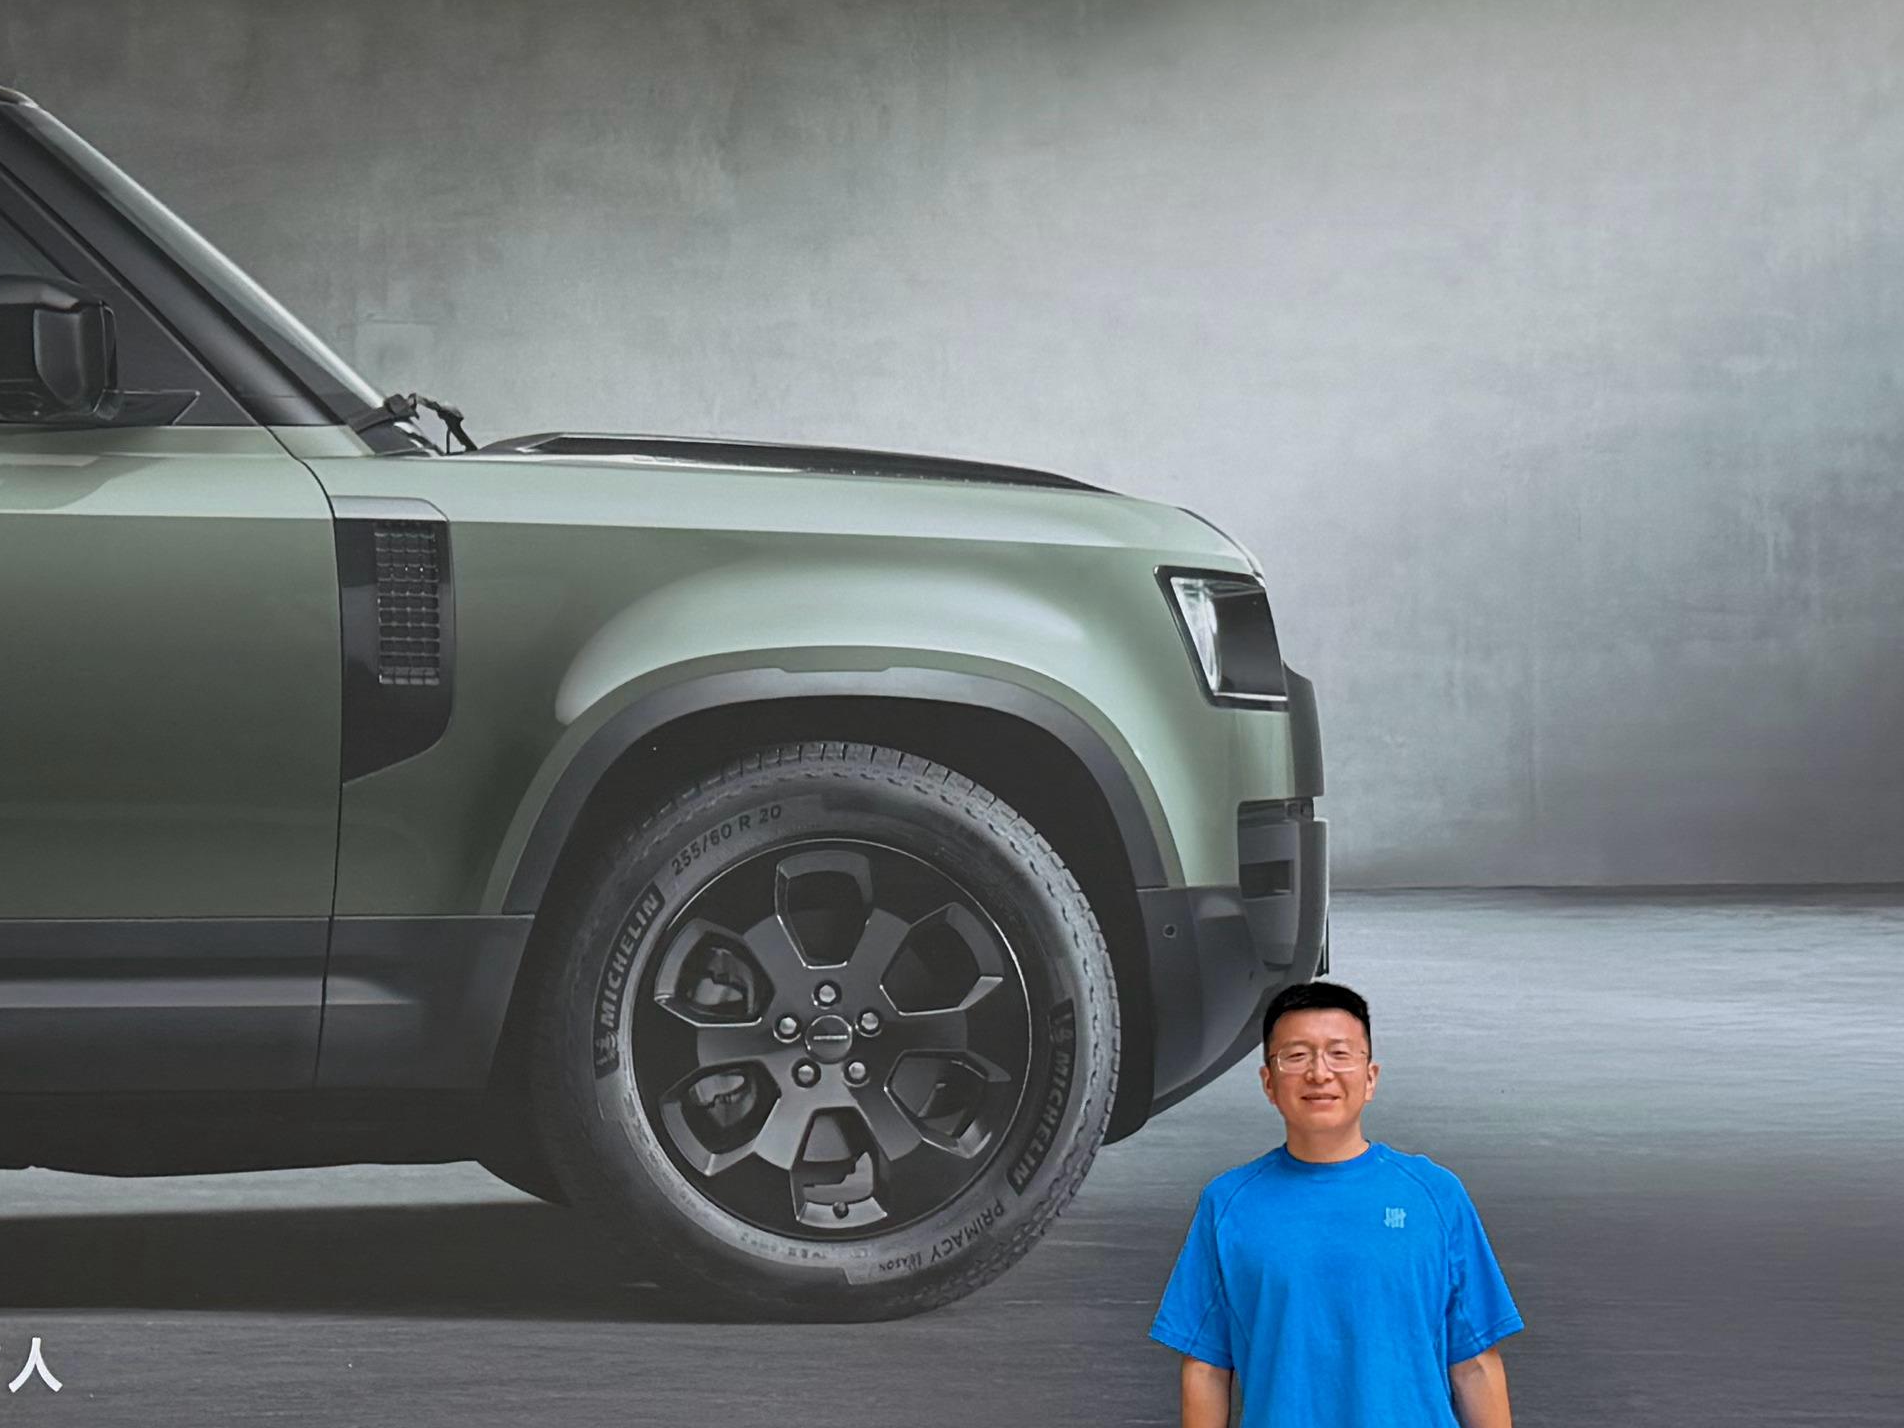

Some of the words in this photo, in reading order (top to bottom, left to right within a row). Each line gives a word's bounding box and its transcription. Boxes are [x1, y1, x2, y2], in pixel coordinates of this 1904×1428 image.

[738, 814, 752, 832] R
[759, 805, 783, 824] 20
[599, 893, 660, 1030] MICHELIN
[1013, 1052, 1072, 1190] MICHELIN
[931, 1198, 1005, 1263] PRIMACY
